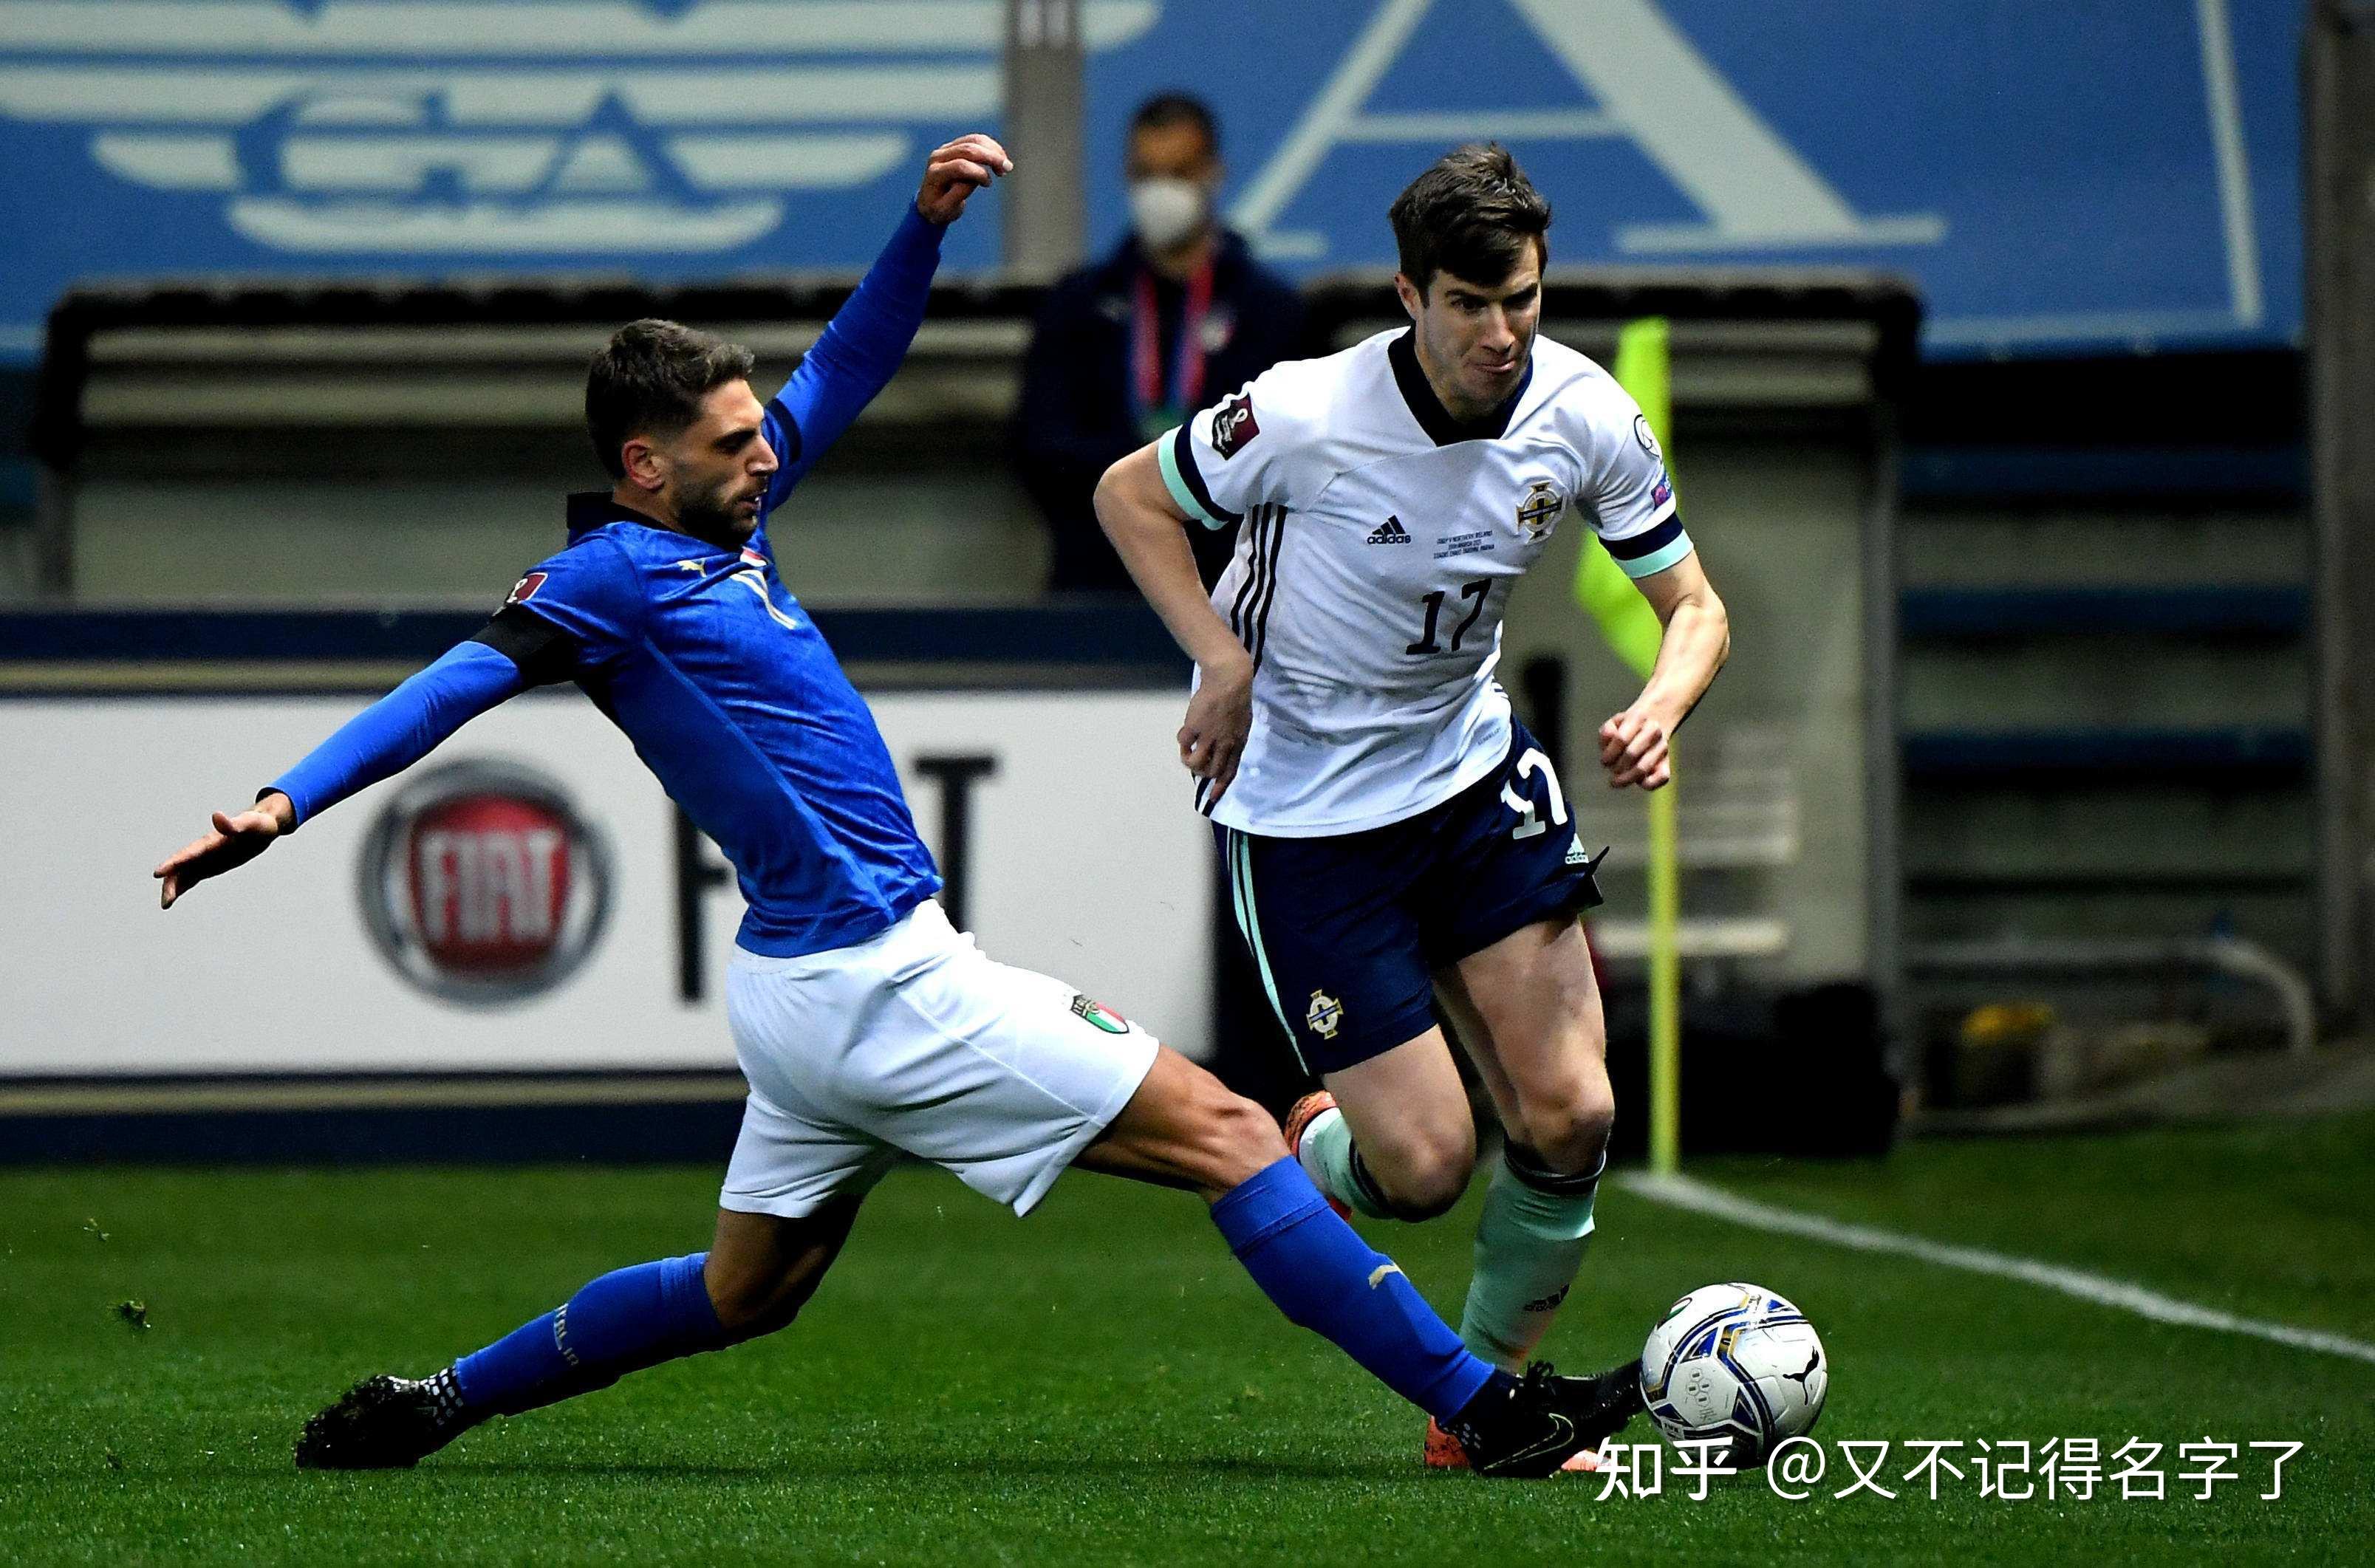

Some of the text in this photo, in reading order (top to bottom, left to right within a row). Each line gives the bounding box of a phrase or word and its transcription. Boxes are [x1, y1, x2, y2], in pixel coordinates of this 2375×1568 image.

[1367, 533, 1412, 544] adidas
[1406, 578, 1492, 655] 17
[1500, 747, 1568, 839] 17
[421, 827, 561, 944] FIAT
